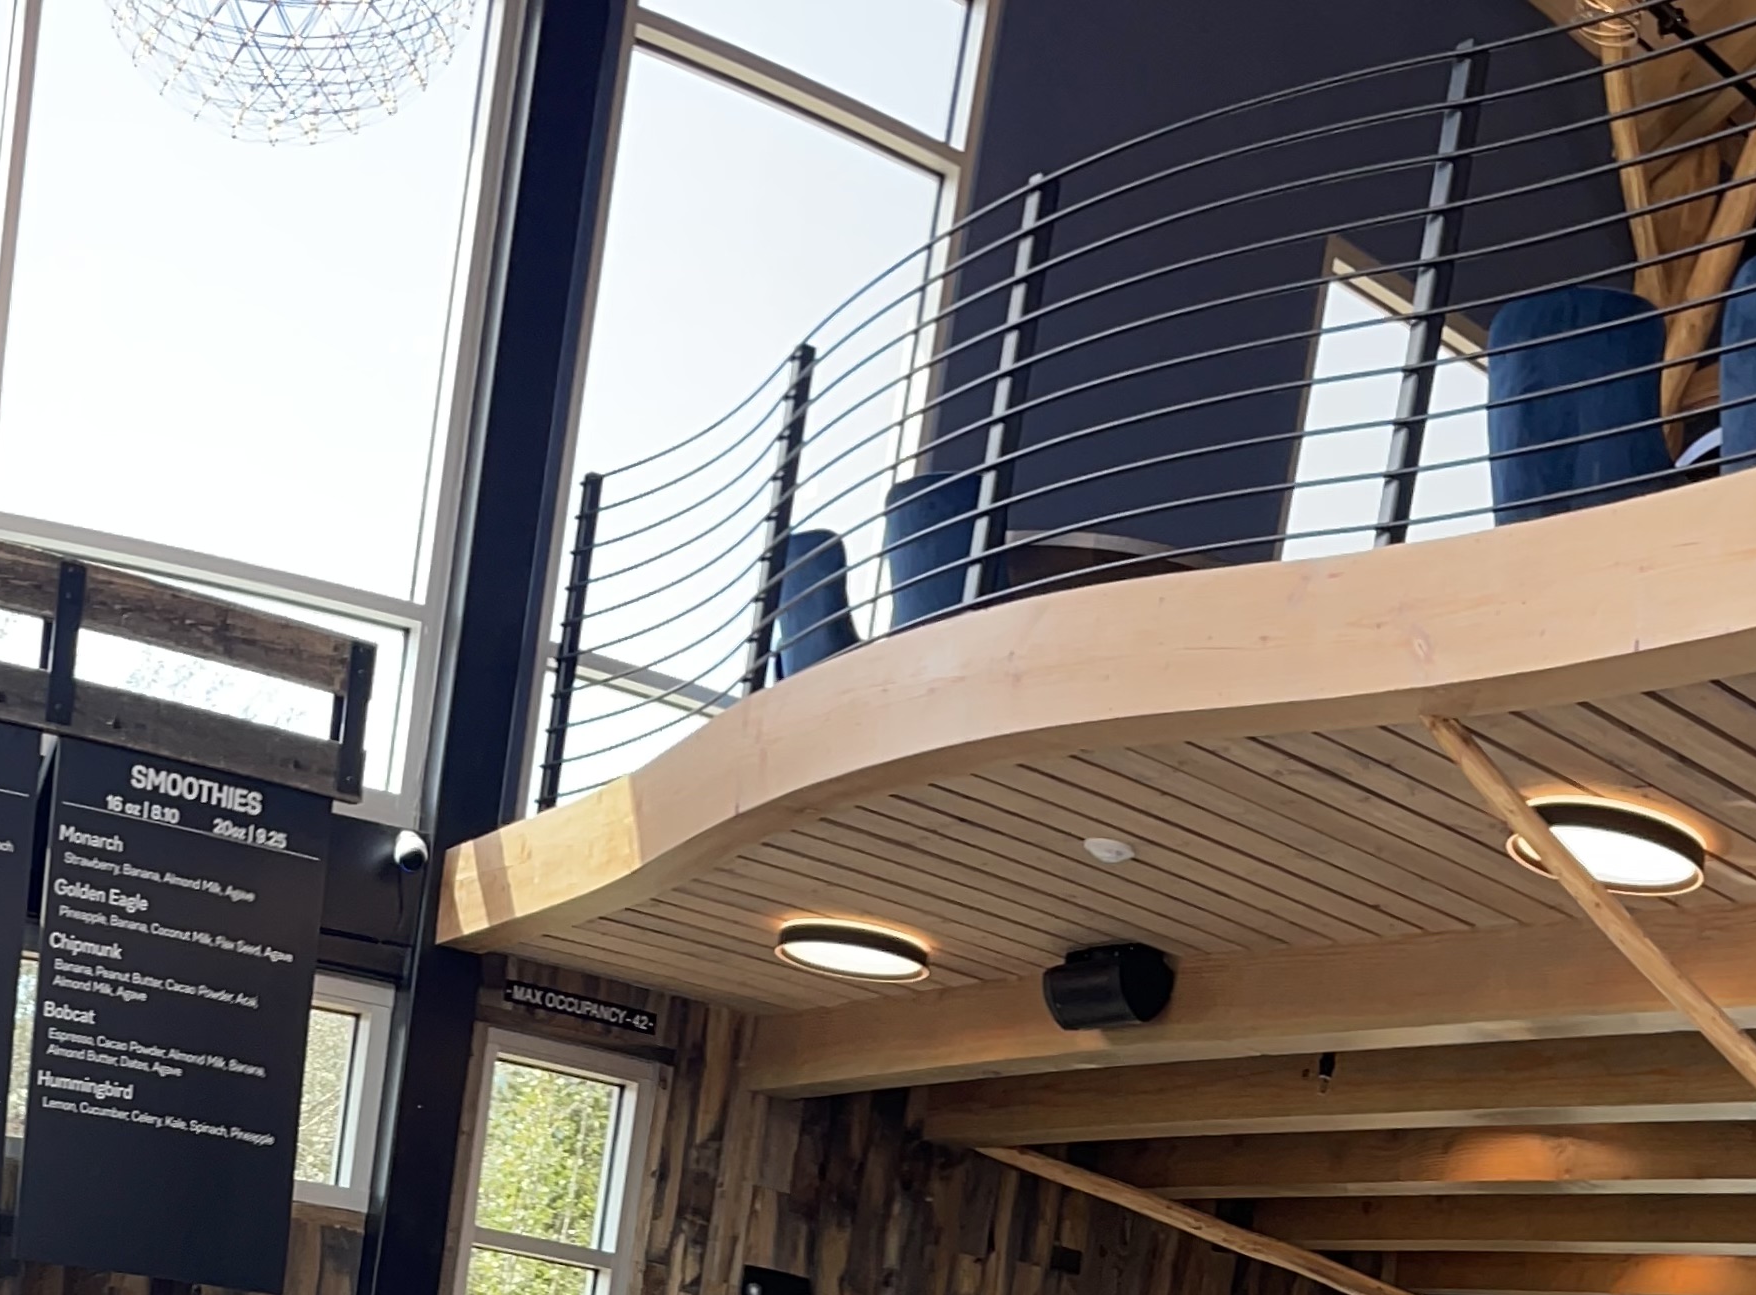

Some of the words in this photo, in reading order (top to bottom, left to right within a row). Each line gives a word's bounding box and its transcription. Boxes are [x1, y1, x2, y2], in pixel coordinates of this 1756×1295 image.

[130, 765, 263, 816] SMOOTHIES
[106, 795, 123, 811] 16
[125, 803, 141, 816] oz
[150, 804, 180, 824] 8.10
[59, 825, 124, 852] Monarch
[213, 818, 247, 841] 20oz
[54, 878, 106, 902] Golden
[109, 888, 148, 913] Eagle
[49, 932, 122, 960] Chipmunk
[43, 1001, 96, 1024] Bobcat
[37, 1070, 134, 1100] Hummingbird
